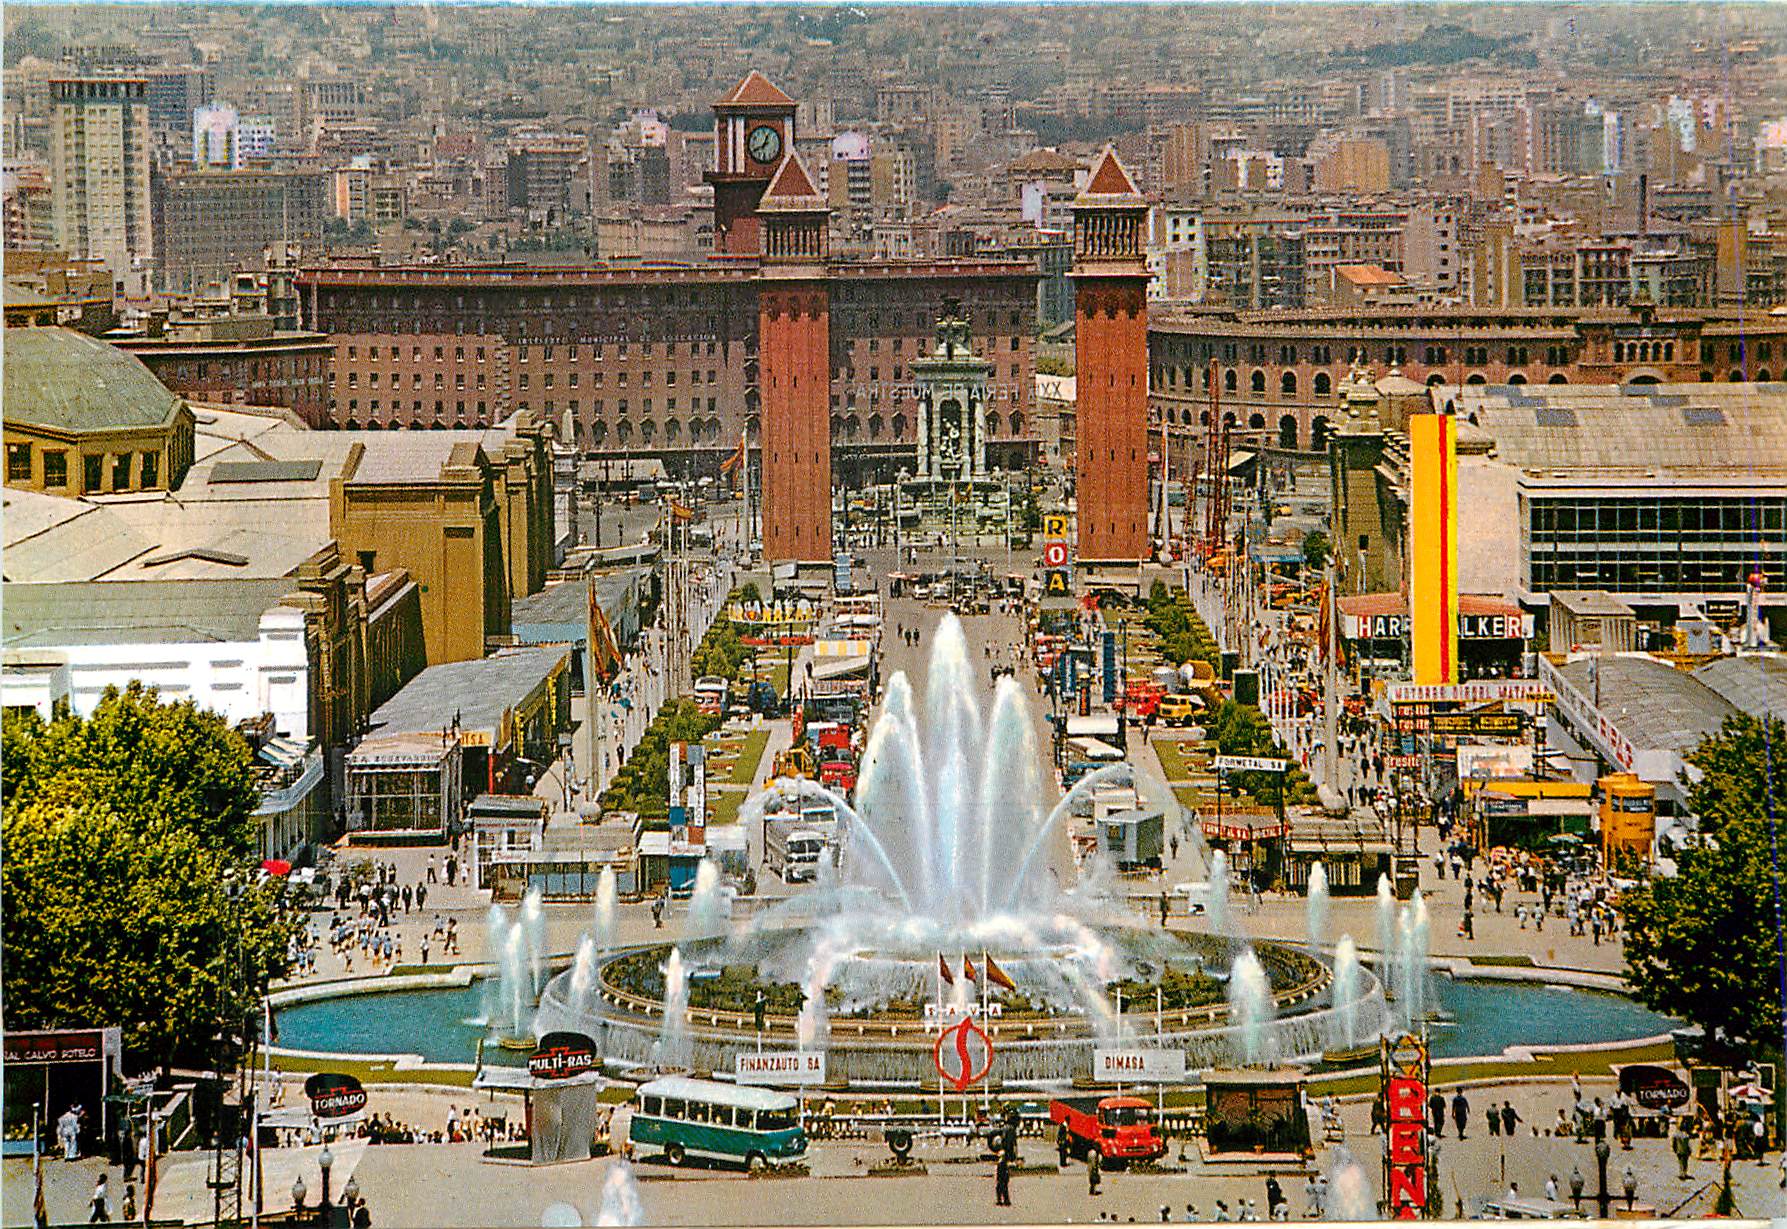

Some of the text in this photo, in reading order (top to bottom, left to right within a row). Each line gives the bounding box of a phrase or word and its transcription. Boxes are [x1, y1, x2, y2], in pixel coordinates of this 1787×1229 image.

[1047, 519, 1066, 591] ROA
[1458, 616, 1521, 637] LKER
[24, 1049, 57, 1060] CALVO
[740, 1057, 799, 1072] FINANZAUTO
[1105, 1056, 1145, 1072] DIMASA
[314, 1093, 365, 1110] TORNADO
[1640, 1088, 1688, 1100] TORNADO
